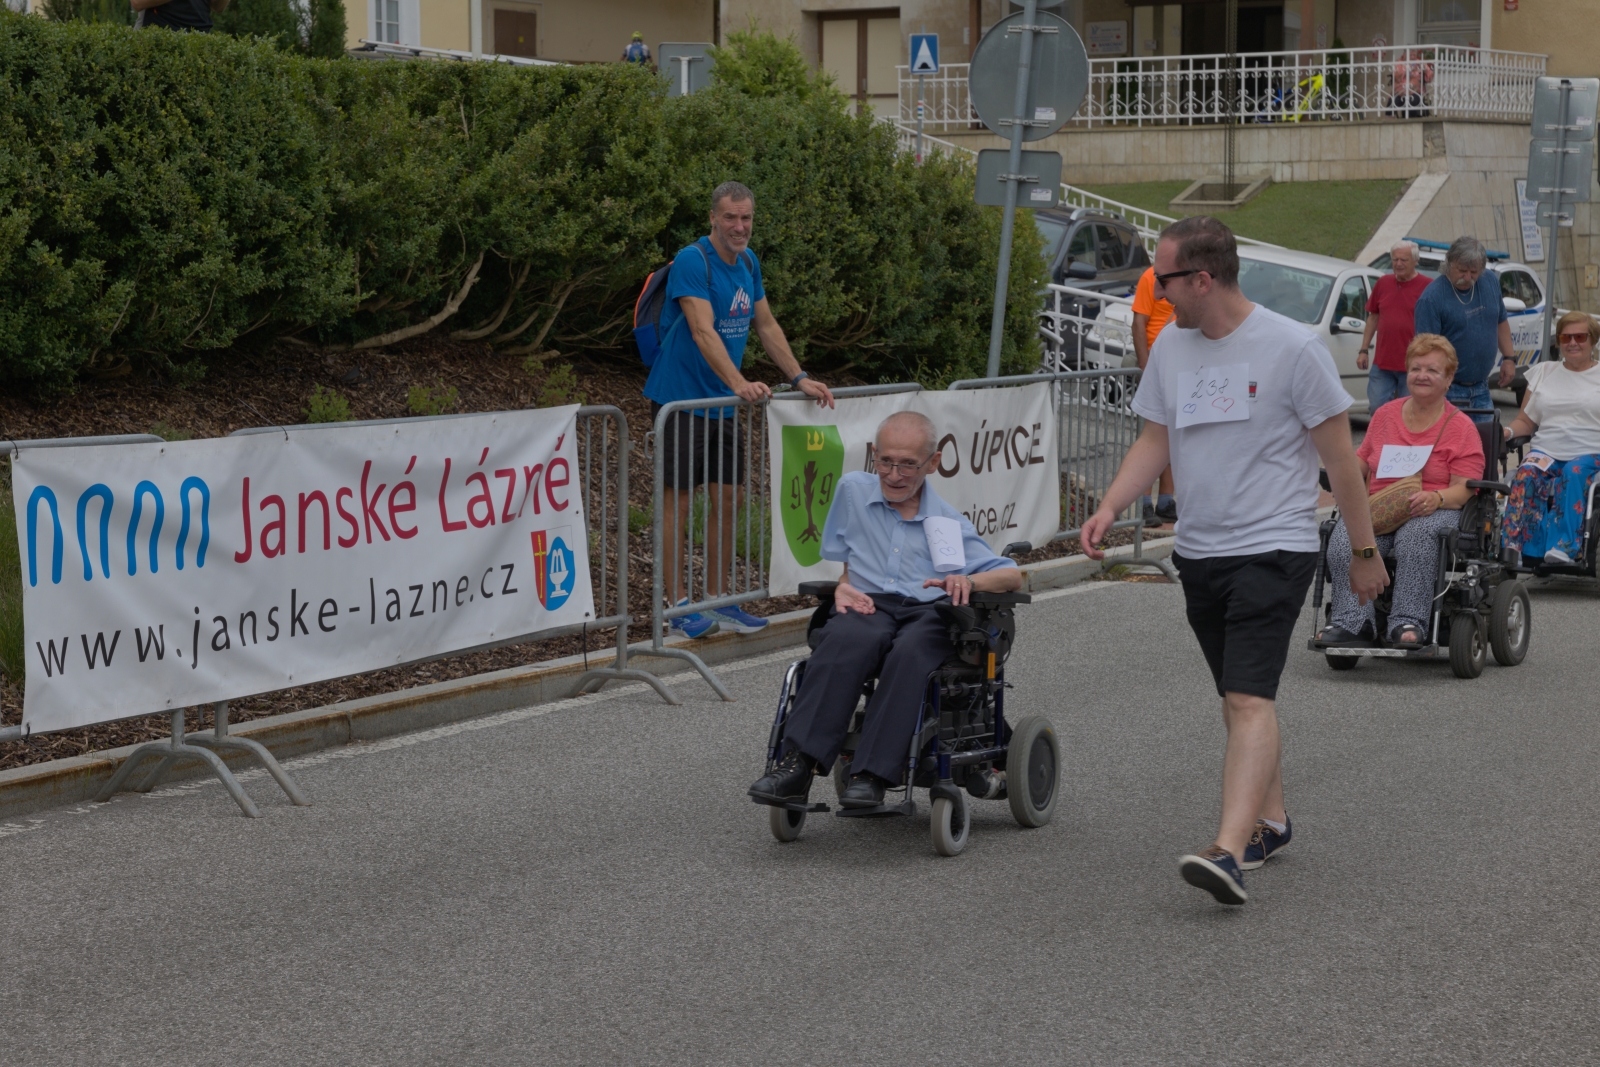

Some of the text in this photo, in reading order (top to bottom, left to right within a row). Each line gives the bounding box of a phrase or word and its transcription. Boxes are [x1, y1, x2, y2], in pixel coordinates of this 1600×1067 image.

[1191, 378, 1229, 399] 238
[970, 419, 1045, 475] ÚPICE
[1389, 451, 1420, 464] 232
[234, 455, 419, 563] Janské
[36, 563, 518, 678] www.janske-lazne.cz
